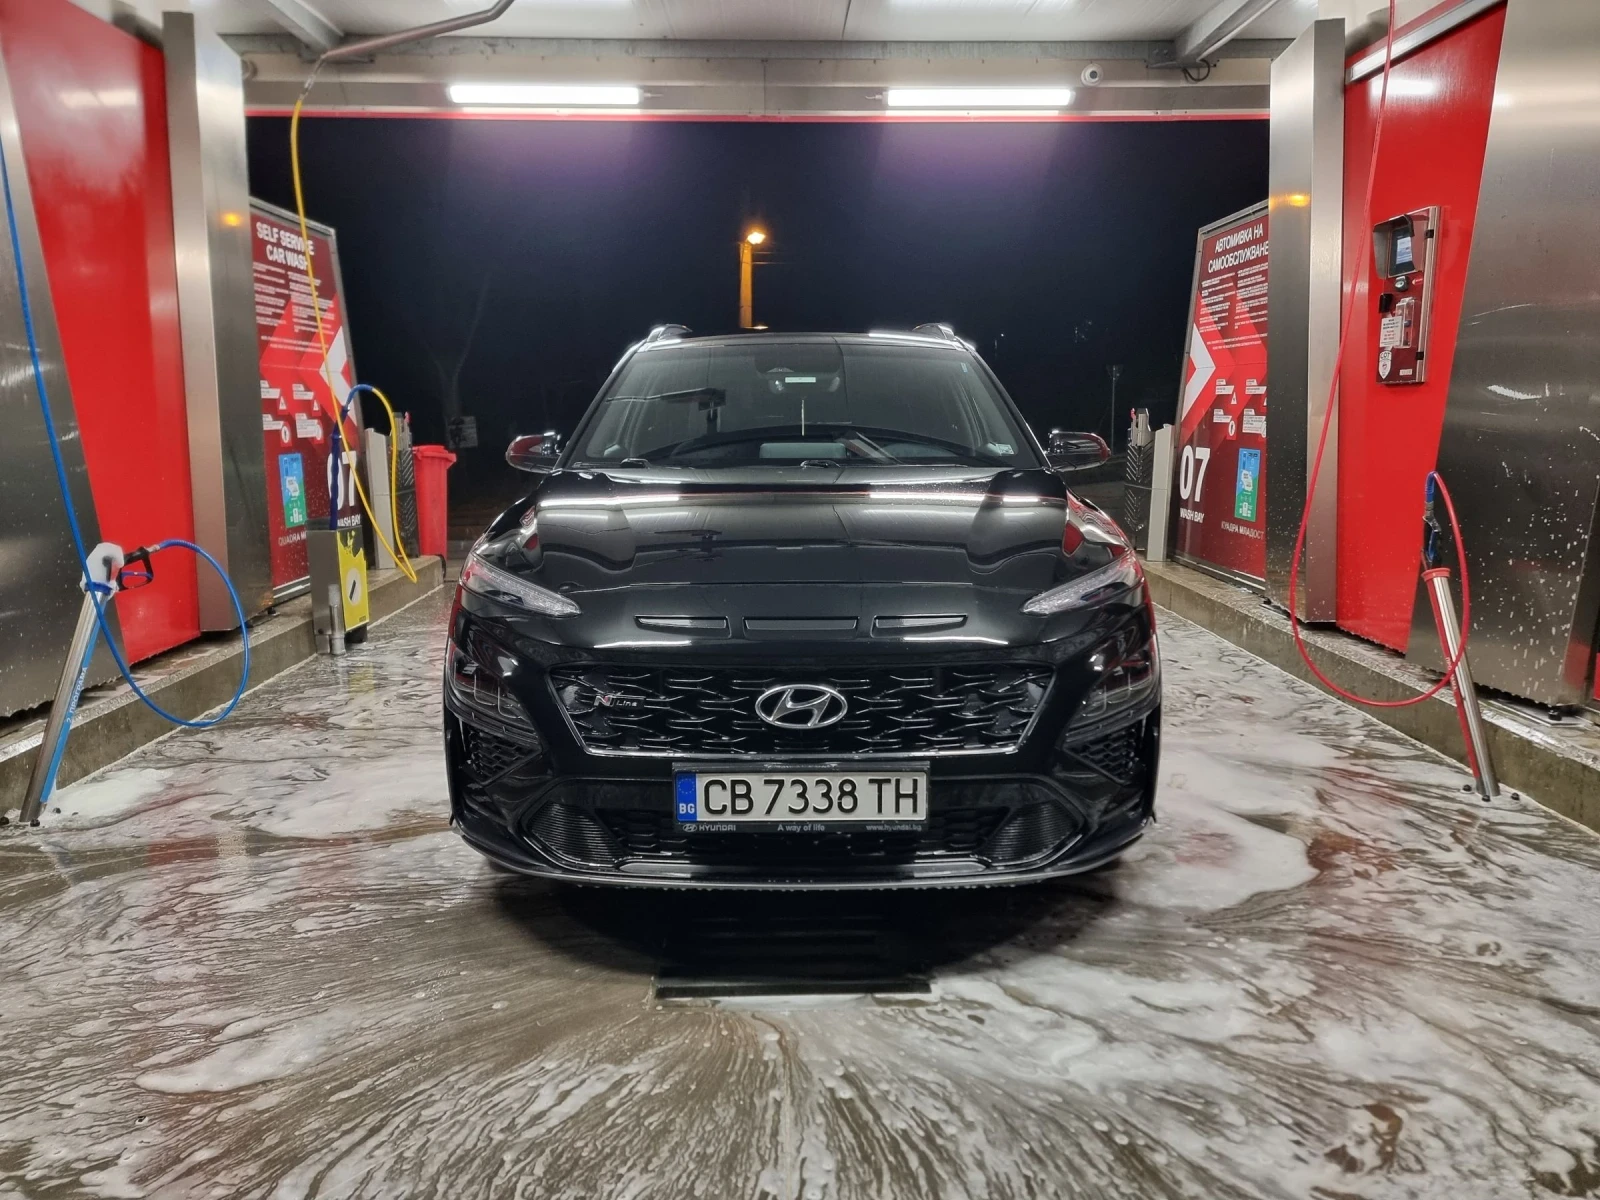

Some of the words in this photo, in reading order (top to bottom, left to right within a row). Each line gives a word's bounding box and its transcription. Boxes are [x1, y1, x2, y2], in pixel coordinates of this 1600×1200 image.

[256, 221, 279, 243] SELF
[280, 230, 314, 256] SERVIE
[1215, 227, 1252, 253] АВТОМИВКА
[1253, 222, 1263, 240] НА
[266, 244, 286, 265] CAR
[1208, 240, 1268, 273] САМООБСЛУЖВАНЕ
[327, 450, 357, 511] 07
[1180, 445, 1210, 502] 07
[351, 513, 361, 526] BAY
[1180, 507, 1194, 521] WASH
[1194, 511, 1205, 523] BAY
[278, 532, 301, 546] QUADRA
[1239, 525, 1265, 540] МЛАДОСТ
[70, 667, 88, 713] ПРОГРАМА
[679, 804, 695, 814] BG
[703, 778, 754, 815] CB
[763, 778, 859, 815] 7338
[868, 778, 918, 814] TH
[803, 823, 812, 831] of
[813, 823, 825, 831] life
